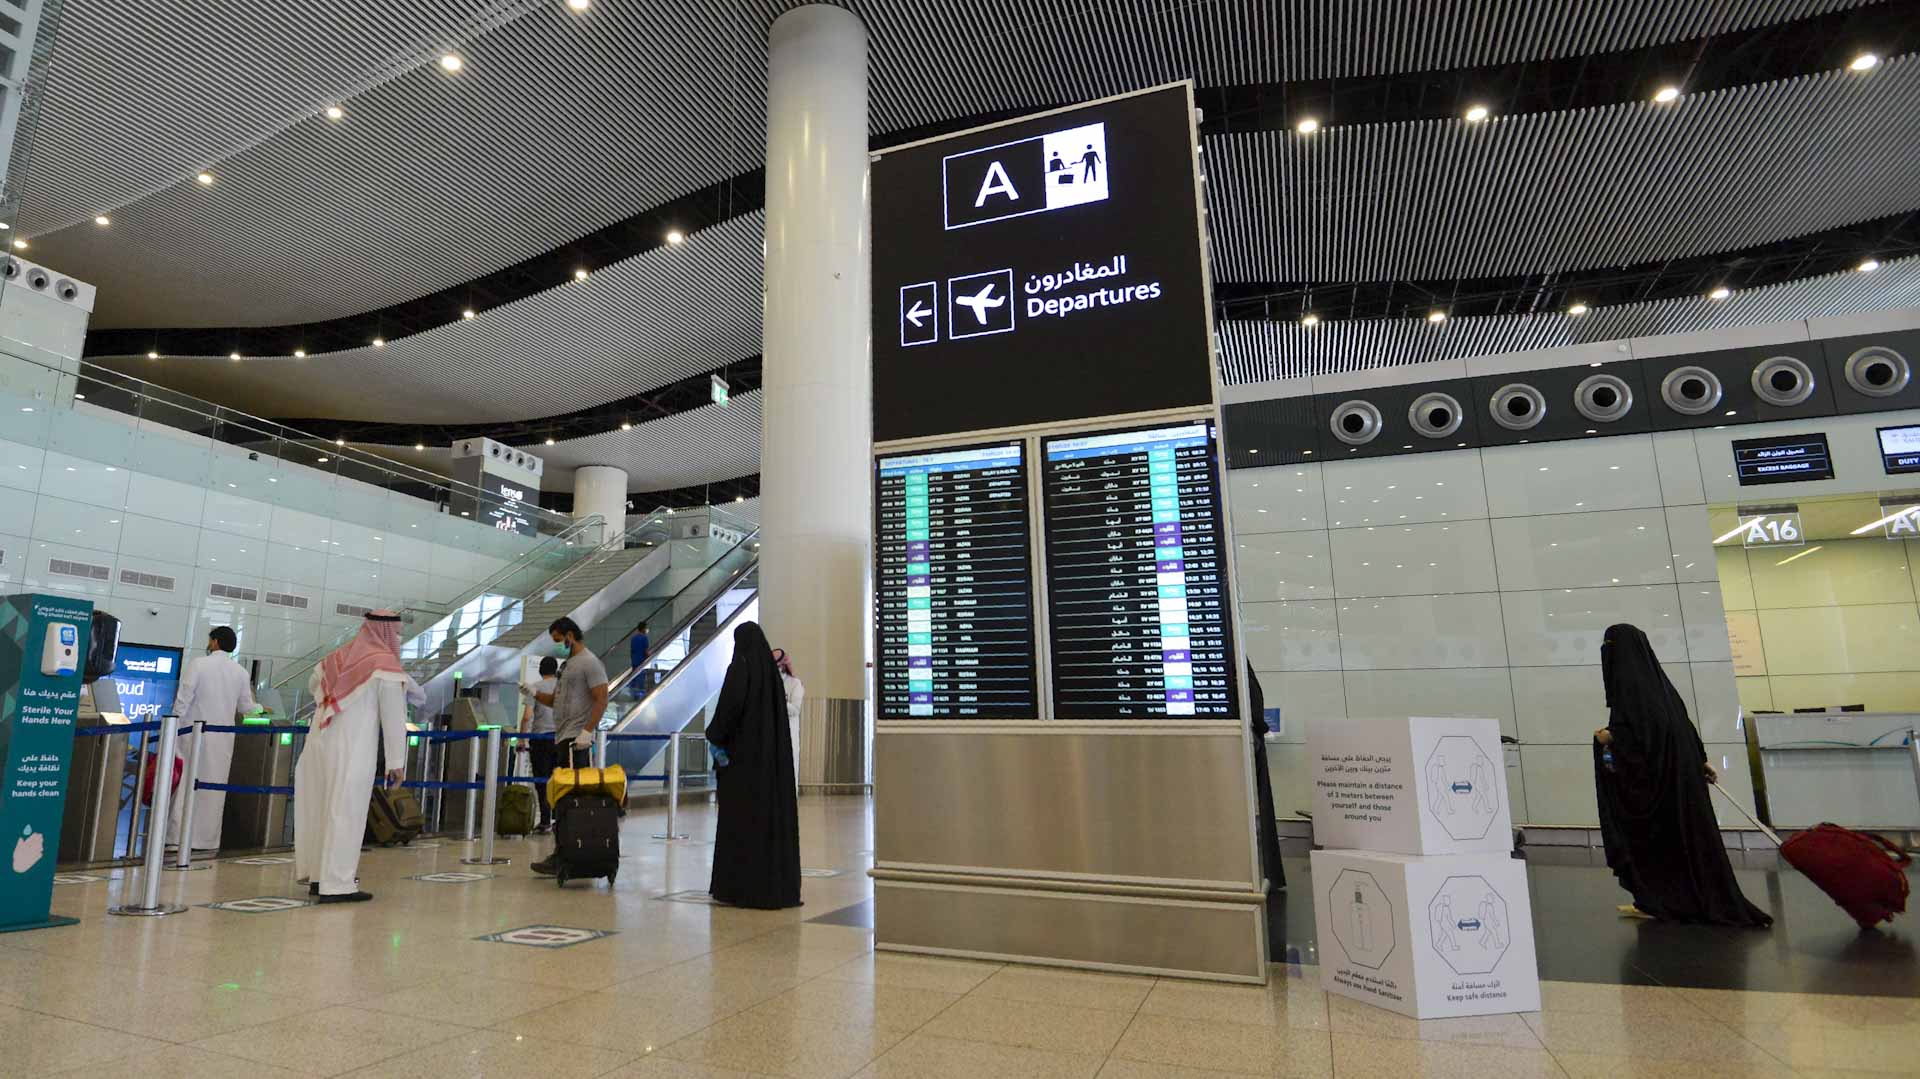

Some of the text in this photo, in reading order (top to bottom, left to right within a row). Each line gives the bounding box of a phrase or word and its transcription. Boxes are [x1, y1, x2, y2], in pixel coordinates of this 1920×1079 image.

[974, 160, 1020, 208] A
[1024, 255, 1126, 294] المغادرون
[1026, 282, 1162, 318] Departures
[1892, 510, 1920, 534] A1
[1747, 519, 1798, 543] A16
[24, 688, 36, 696] هنا
[22, 706, 51, 714] Sterile
[129, 704, 162, 720] year
[22, 716, 71, 725] Hands Here
[21, 754, 38, 763] على
[16, 780, 38, 788] Keep
[1334, 976, 1352, 988] Always
